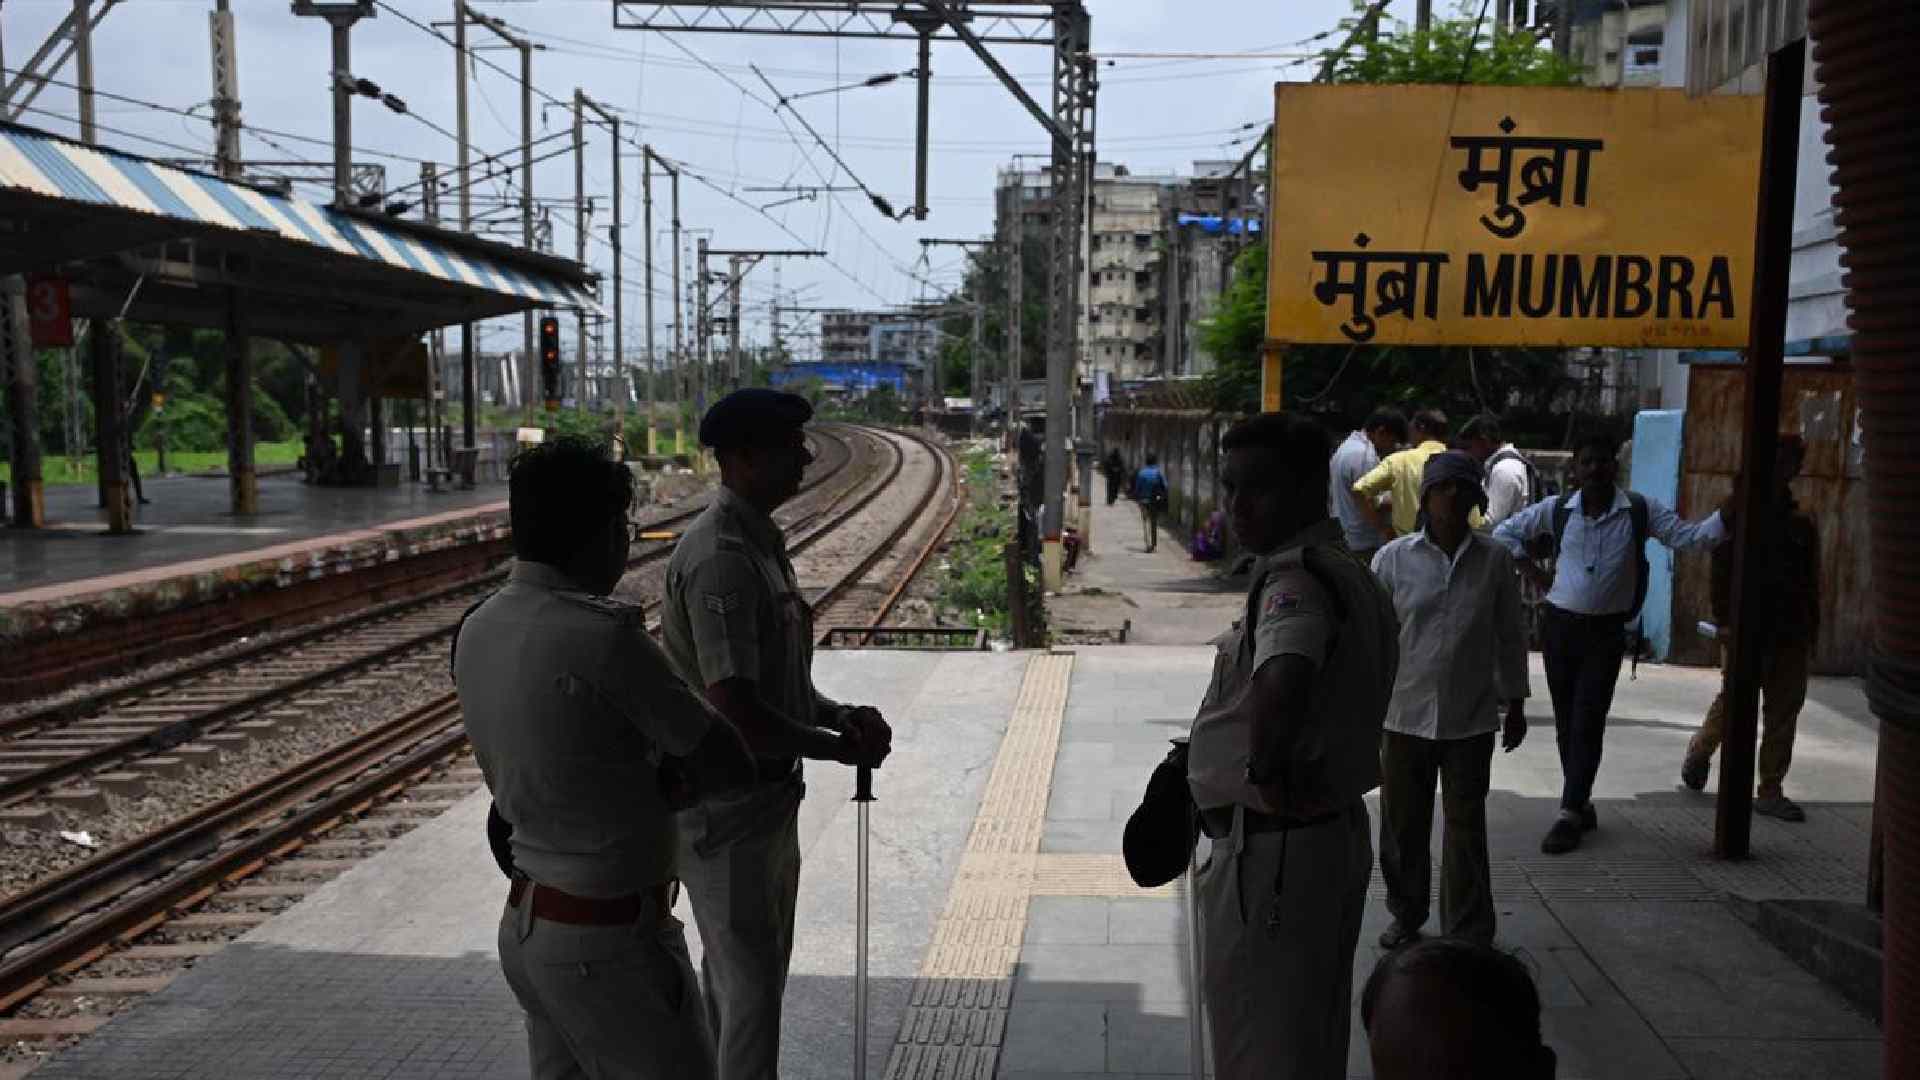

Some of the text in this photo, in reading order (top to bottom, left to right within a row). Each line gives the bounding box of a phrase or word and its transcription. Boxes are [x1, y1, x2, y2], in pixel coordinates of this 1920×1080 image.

[1450, 115, 1604, 239] मुंब्रा
[33, 281, 59, 321] 3
[1311, 233, 1736, 342] मुंब्रा MUMBRA
